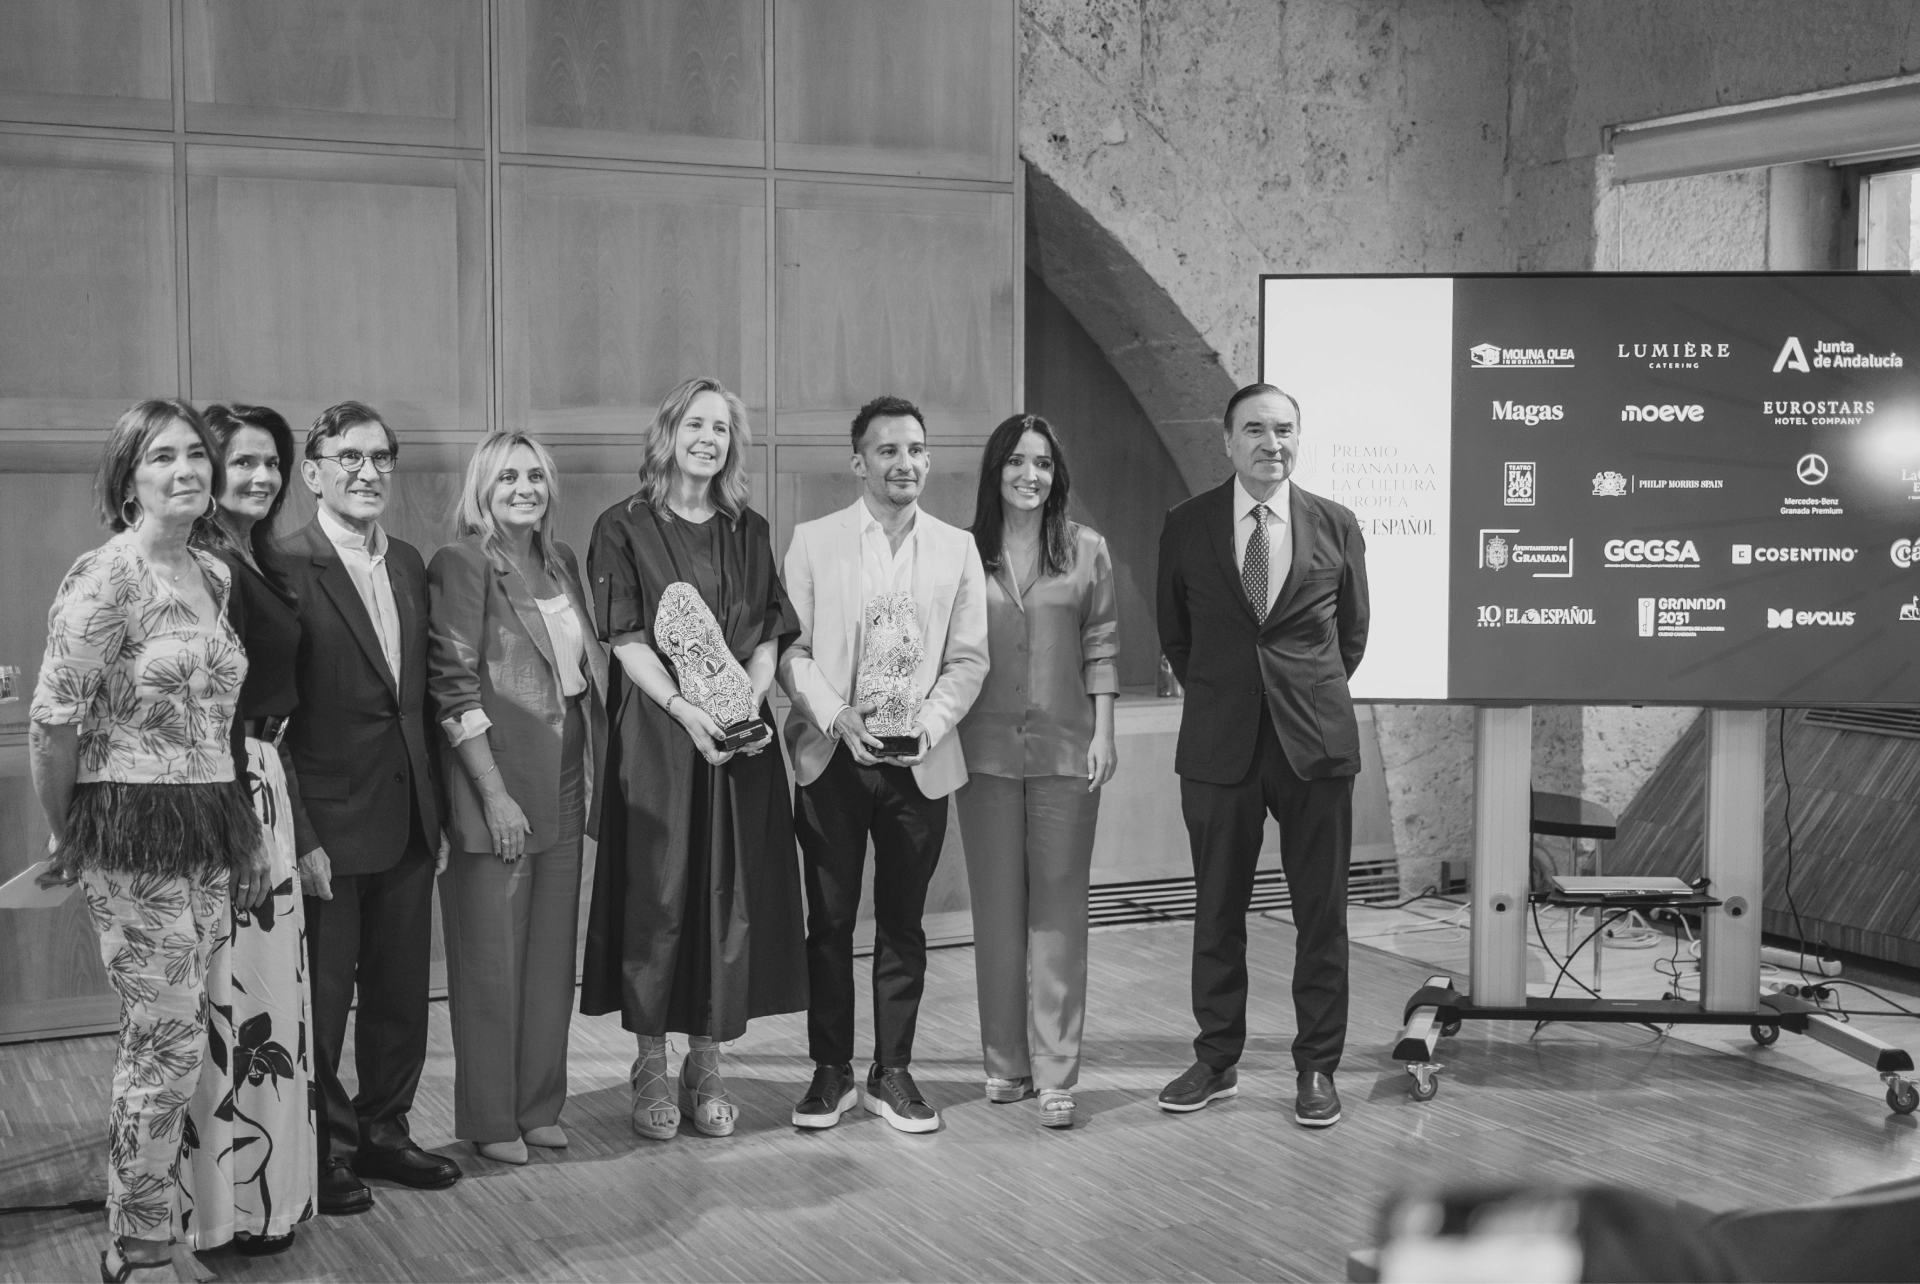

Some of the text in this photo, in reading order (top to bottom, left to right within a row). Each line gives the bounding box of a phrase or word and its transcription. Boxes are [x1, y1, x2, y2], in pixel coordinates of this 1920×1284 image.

[1502, 348, 1575, 360] MOLINA OLEA
[1617, 341, 1731, 358] LUMIÈRE
[1813, 340, 1855, 354] Junta
[1812, 352, 1904, 369] de Andalucía
[1491, 400, 1564, 426] Magas
[1621, 404, 1705, 422] moeve
[1763, 400, 1876, 415] EUROSTARS
[1774, 417, 1863, 426] HOTEL COMPANY
[1332, 444, 1398, 458] PREMIO
[1331, 461, 1435, 475] GRANADA A
[1332, 477, 1436, 491] LA CULTURA
[1639, 480, 1724, 488] PHILIP MORRIS SPAIN
[1332, 494, 1408, 508] EUROPEA
[1784, 497, 1839, 505] Mercedes-Benz
[1372, 515, 1436, 536] ESPAÑOL
[1512, 551, 1567, 563] GRANADA
[1755, 547, 1855, 562] COSENTINO
[1658, 597, 1726, 610] GRANADA
[1477, 605, 1501, 622] 10
[1505, 606, 1596, 625] EL ESPAÑOL
[1658, 611, 1690, 626] 2031
